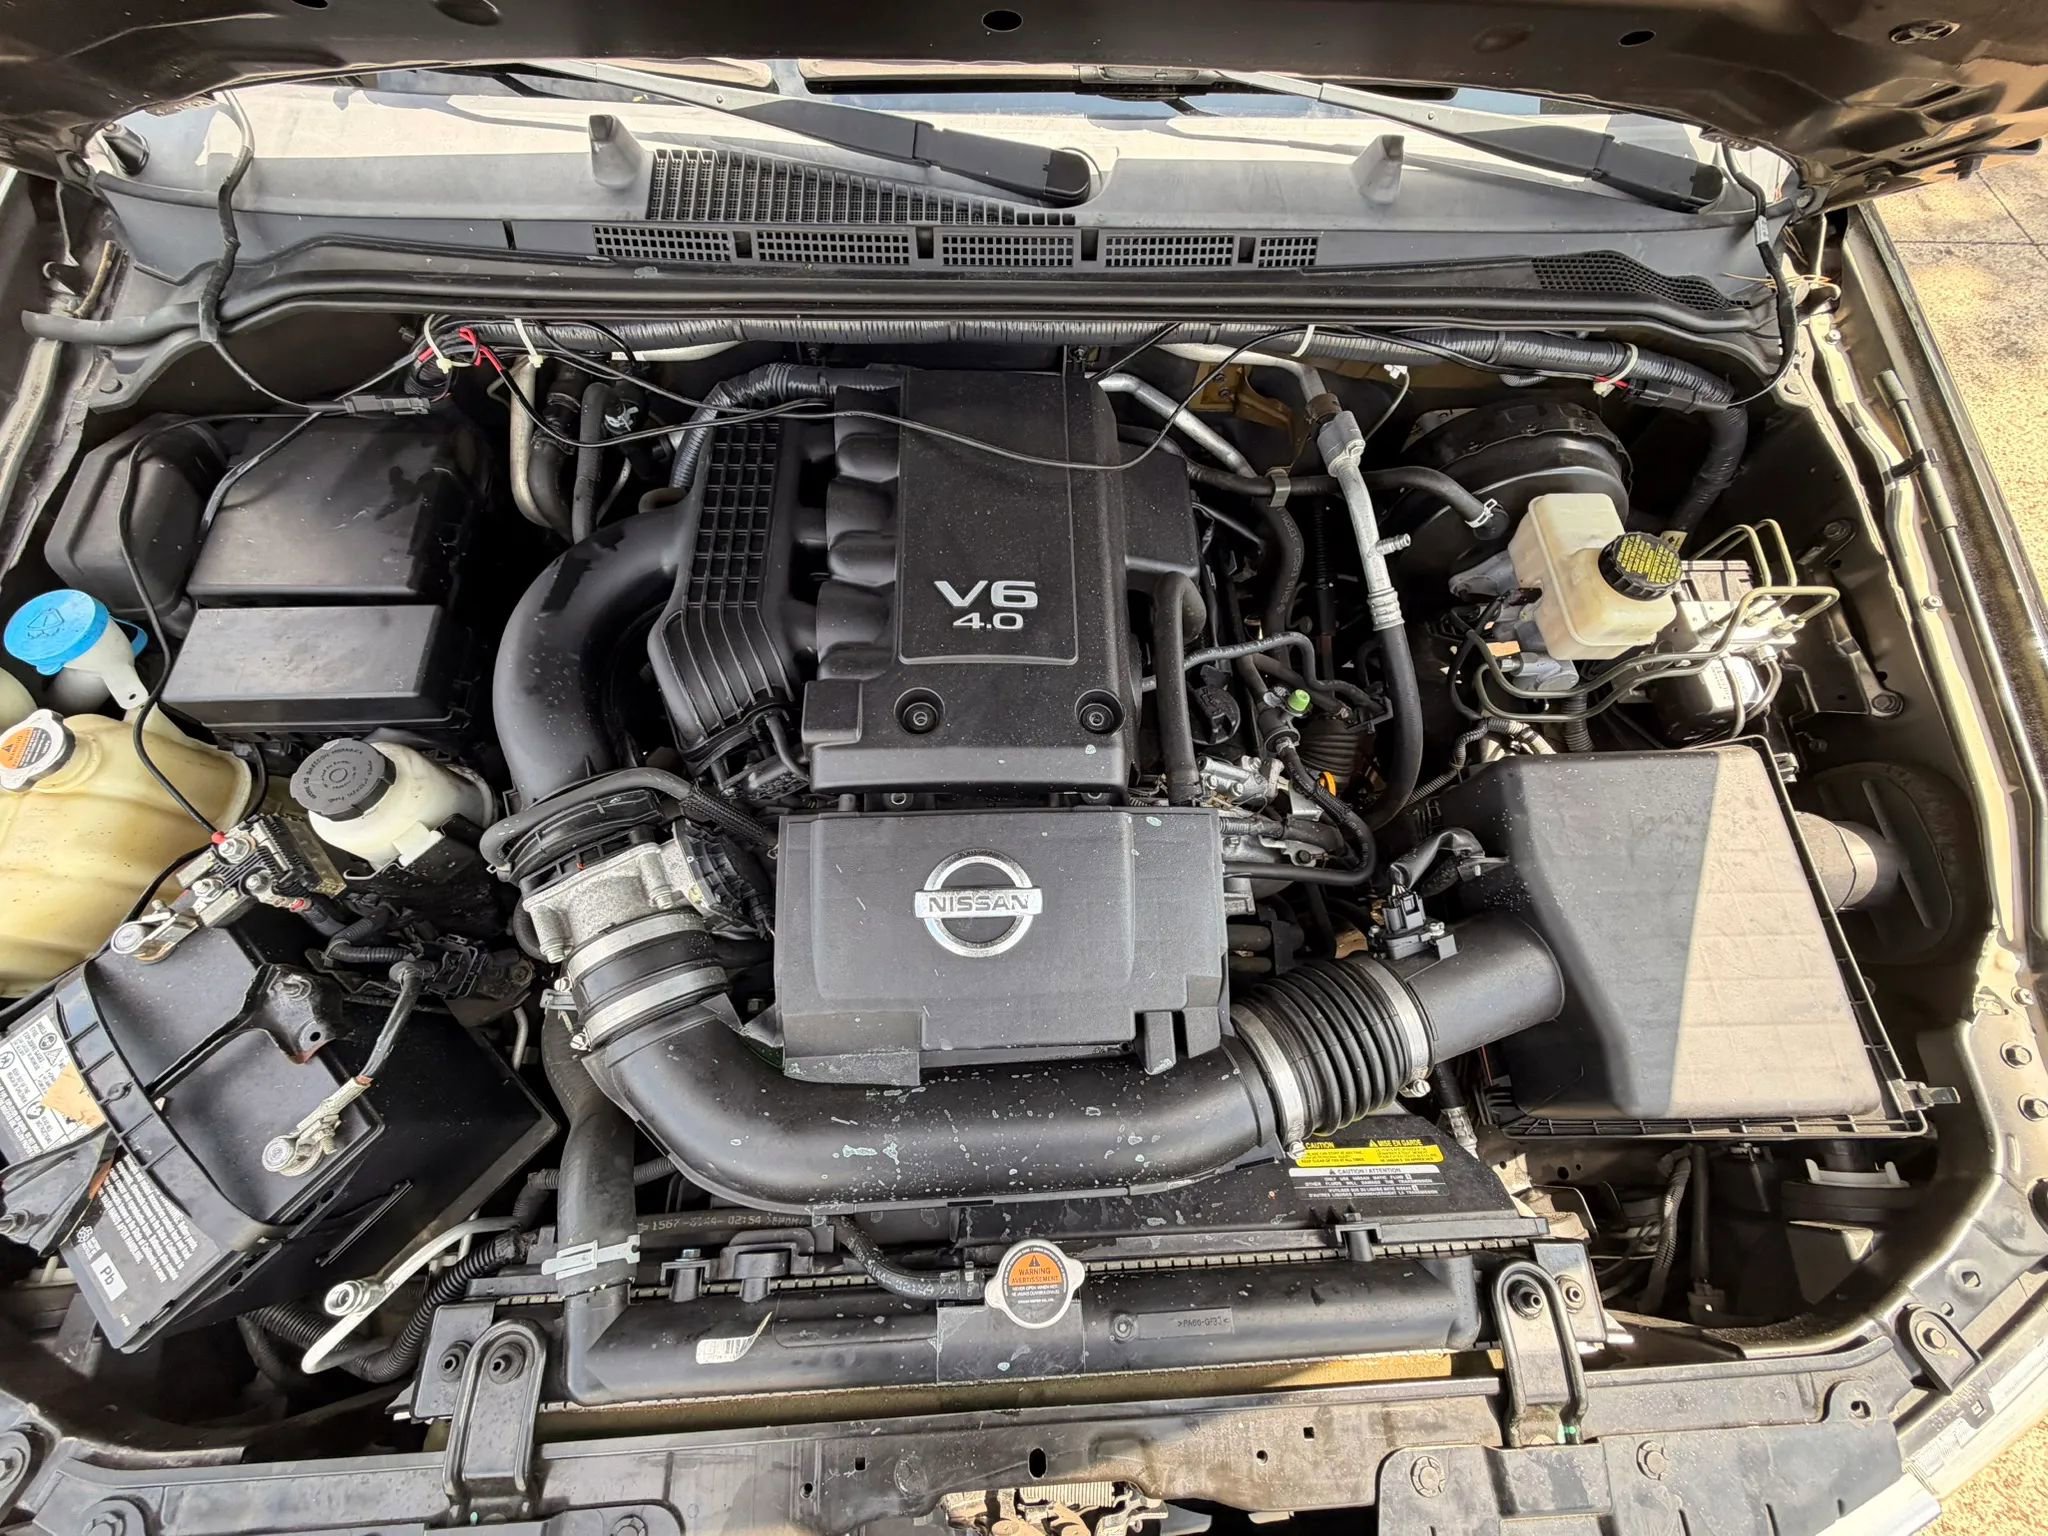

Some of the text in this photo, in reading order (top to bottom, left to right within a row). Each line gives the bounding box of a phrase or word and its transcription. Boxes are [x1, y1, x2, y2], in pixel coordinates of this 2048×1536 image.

[933, 580, 1039, 609] V6
[952, 612, 1024, 630] 4.0
[928, 894, 1029, 912] NISSAN
[100, 1266, 114, 1286] Pb
